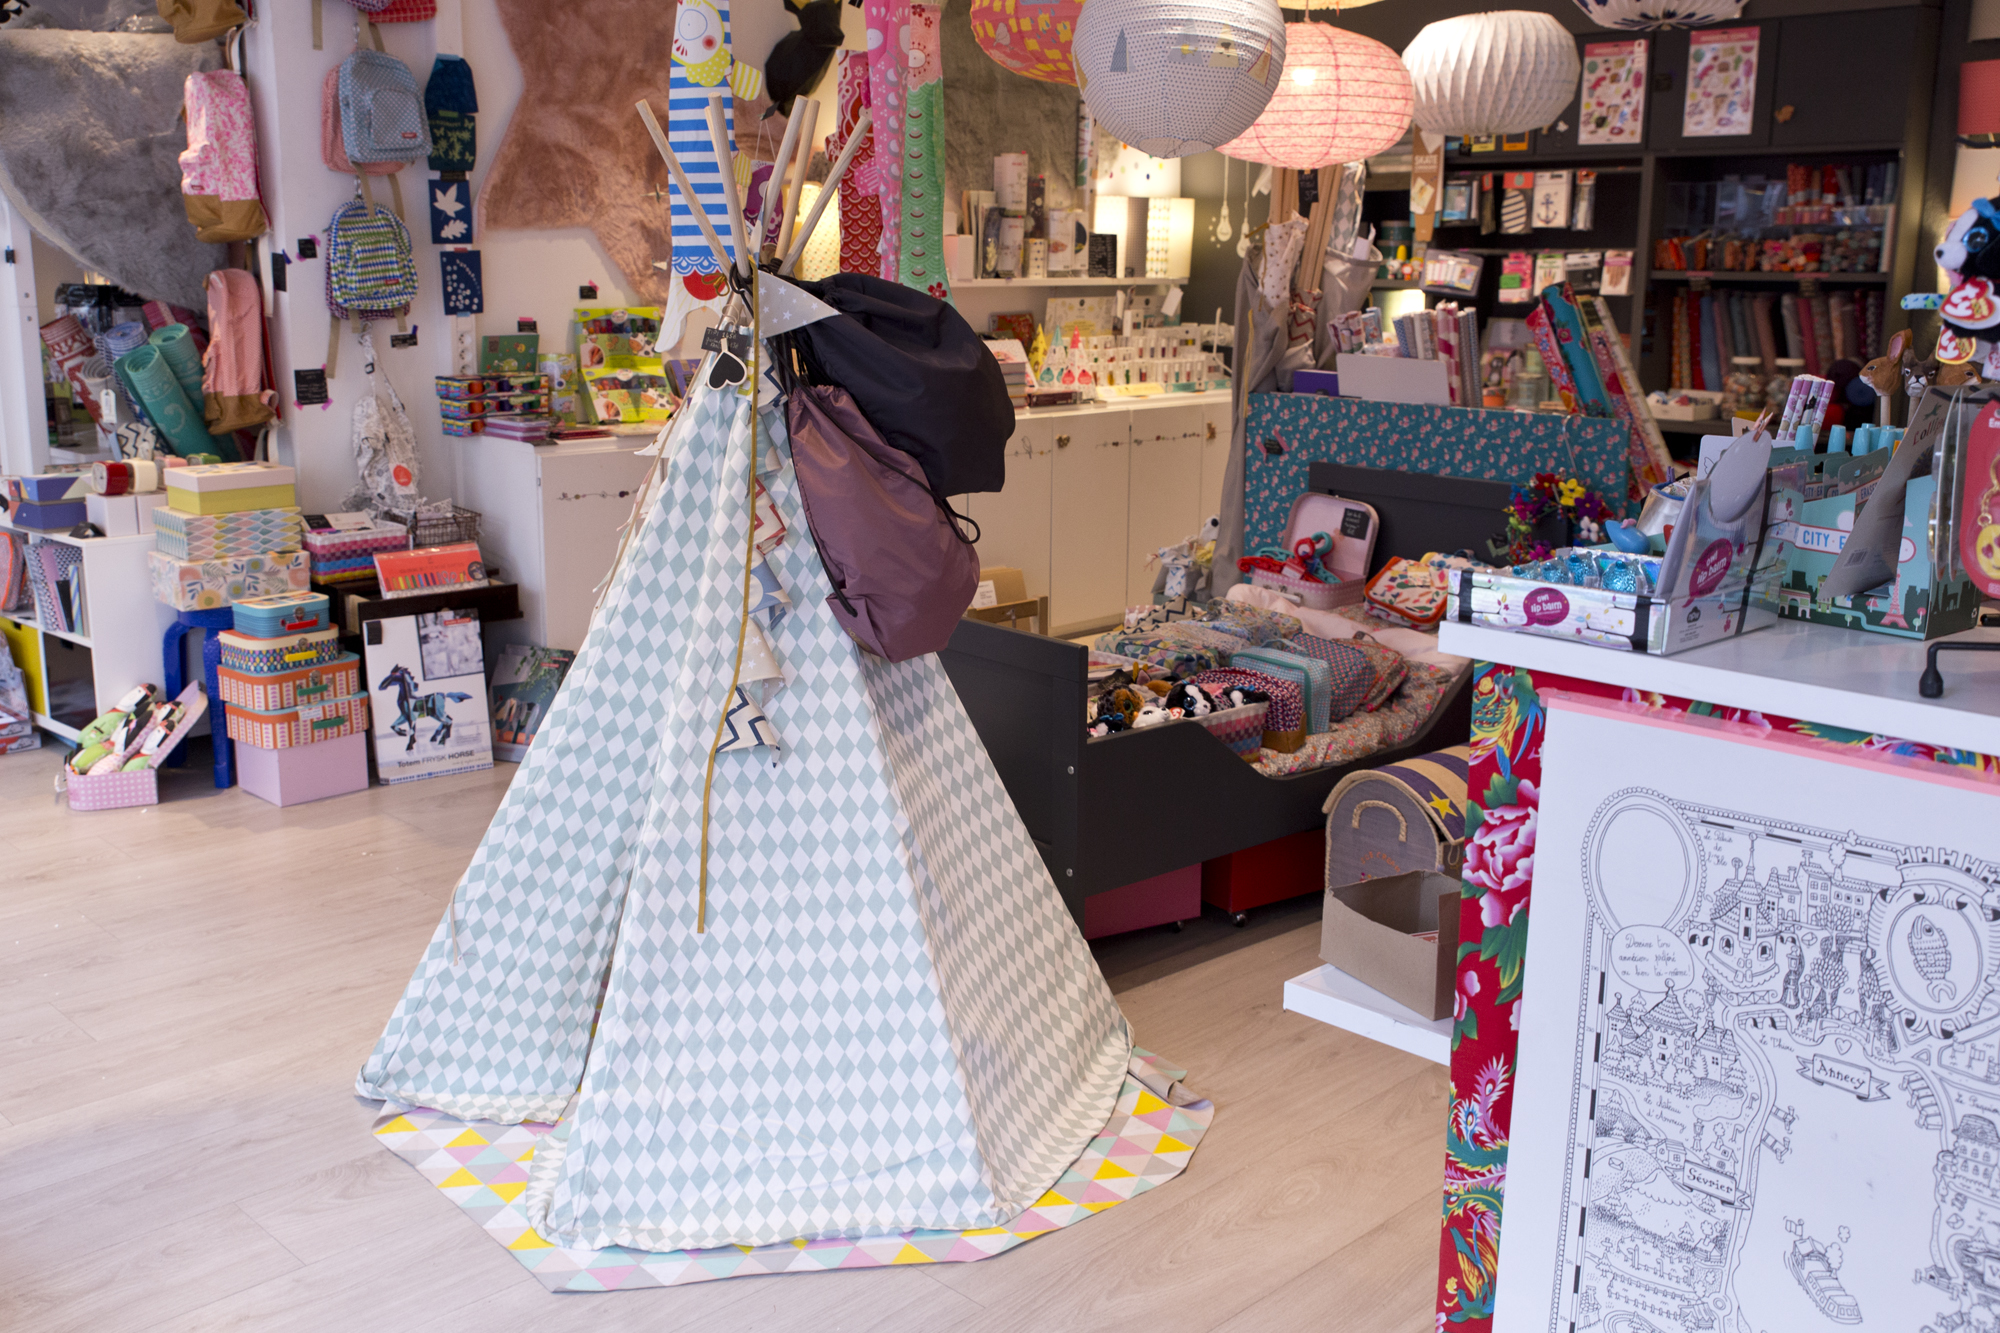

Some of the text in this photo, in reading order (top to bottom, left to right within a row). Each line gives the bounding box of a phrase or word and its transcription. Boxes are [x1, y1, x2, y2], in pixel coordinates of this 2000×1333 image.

[1802, 529, 1830, 548] CITY
[1706, 550, 1718, 567] owl
[1696, 557, 1727, 584] lip balm
[1530, 601, 1563, 613] lip balm
[1536, 594, 1550, 603] owl
[397, 760, 421, 768] Totem
[422, 755, 447, 763] FRYSK
[448, 750, 475, 760] HORSE
[1816, 1060, 1866, 1090] Annecy
[1686, 1167, 1734, 1194] Sévrier
